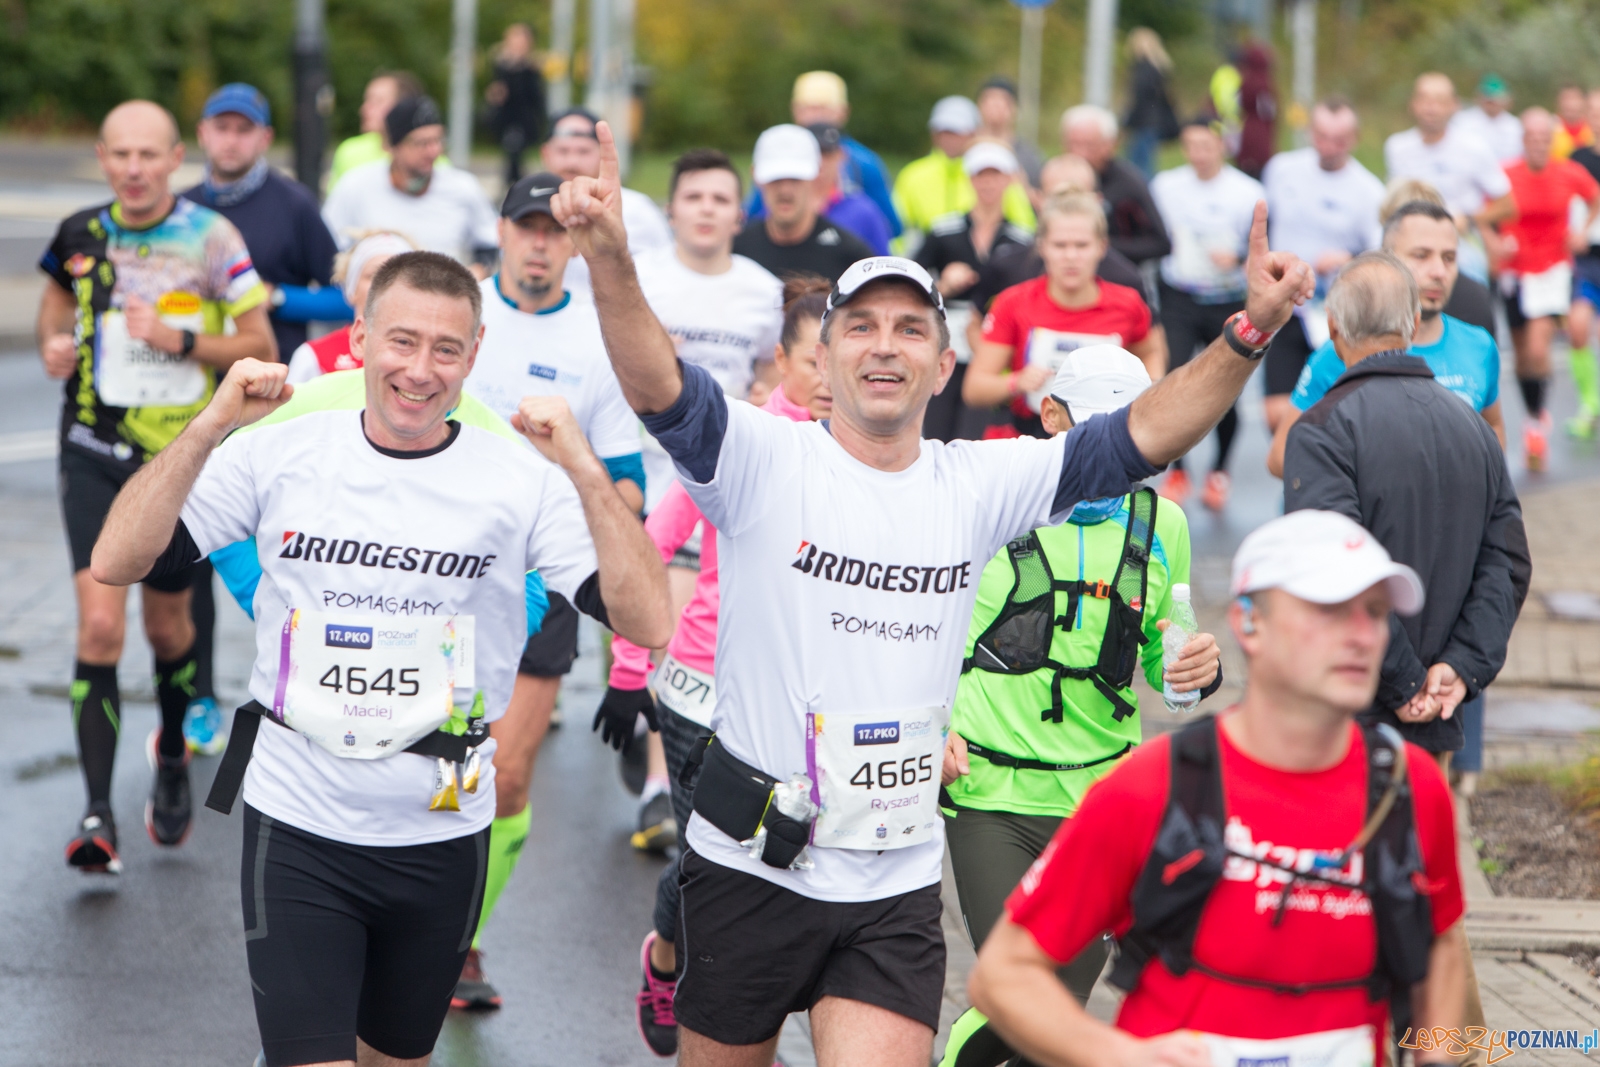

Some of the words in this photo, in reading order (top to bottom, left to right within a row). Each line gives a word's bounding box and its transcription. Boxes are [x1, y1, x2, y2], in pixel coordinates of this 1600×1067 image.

[279, 531, 497, 579] BRIDGESTONE
[323, 590, 444, 616] POMAGAMY
[831, 611, 943, 643] POMAGAMY
[319, 664, 420, 697] 4645
[342, 703, 393, 720] Maciej
[849, 753, 933, 790] 4665
[870, 793, 920, 811] Ryszard
